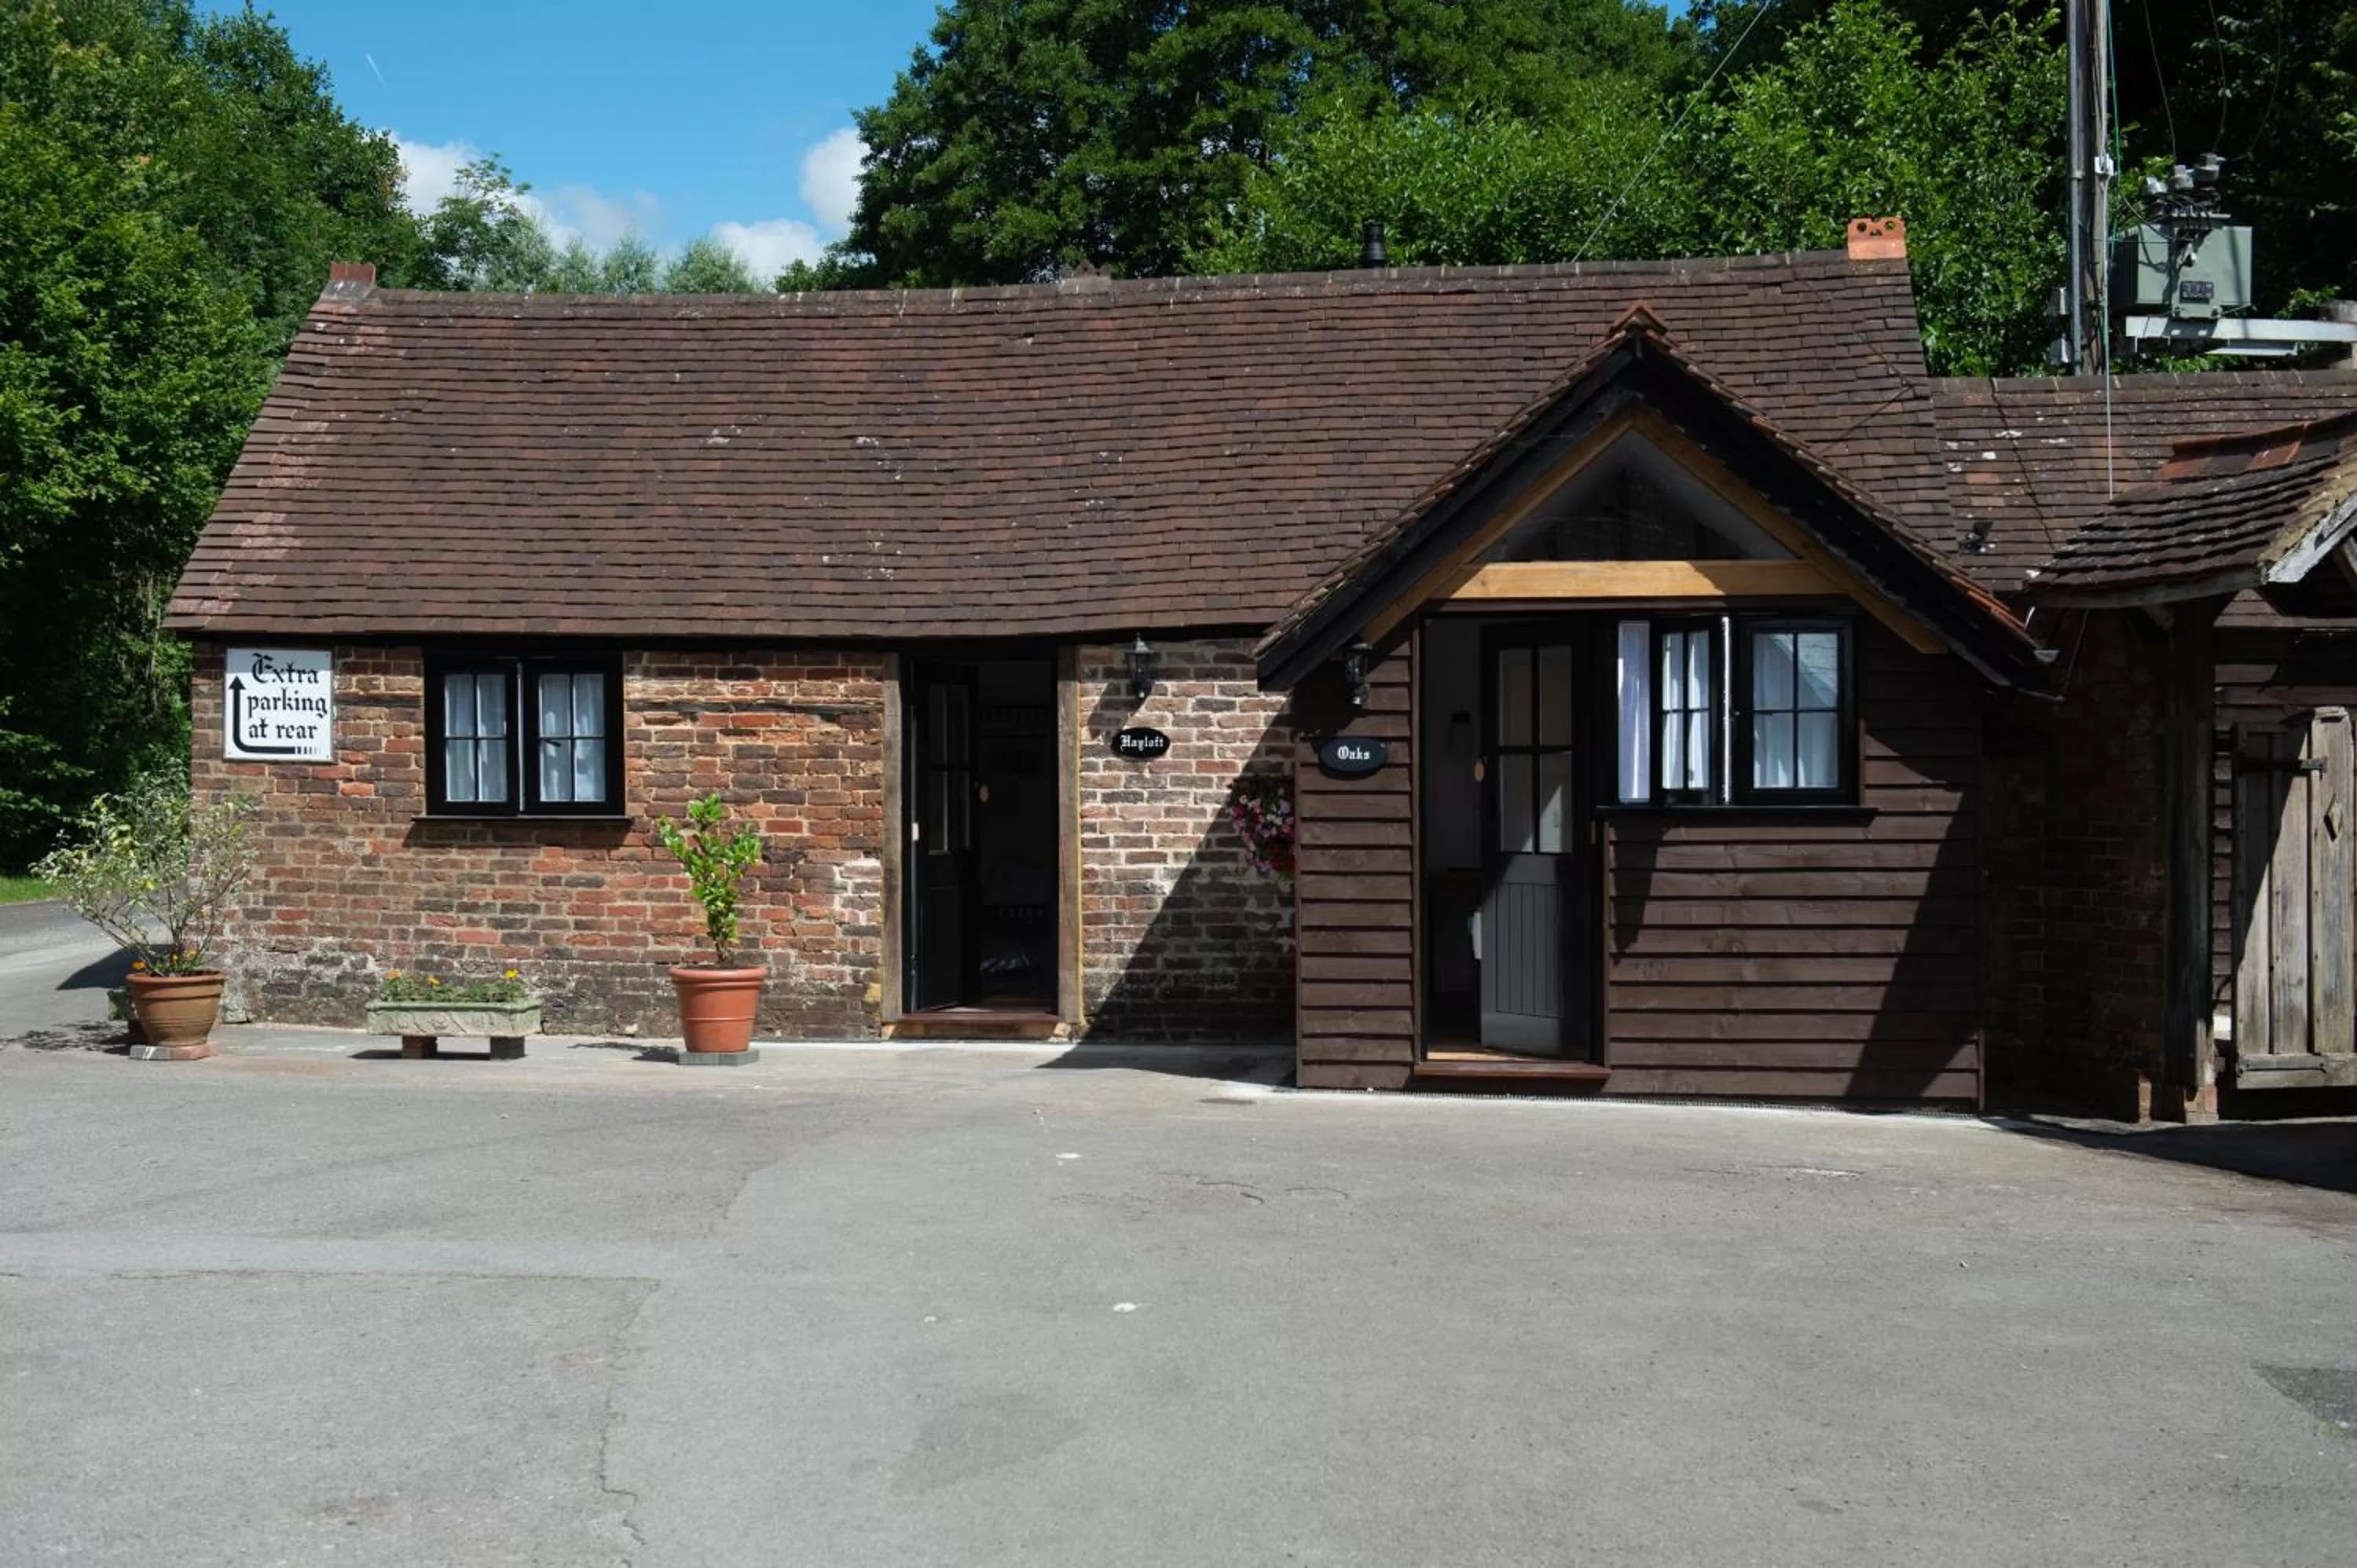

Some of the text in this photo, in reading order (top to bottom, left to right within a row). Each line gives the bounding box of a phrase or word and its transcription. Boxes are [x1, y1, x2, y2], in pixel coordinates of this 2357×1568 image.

[251, 652, 319, 683] Extra
[247, 687, 328, 719] parking
[248, 718, 317, 739] at rear
[1120, 735, 1164, 752] Hayloft
[1337, 746, 1370, 760] Oaks
